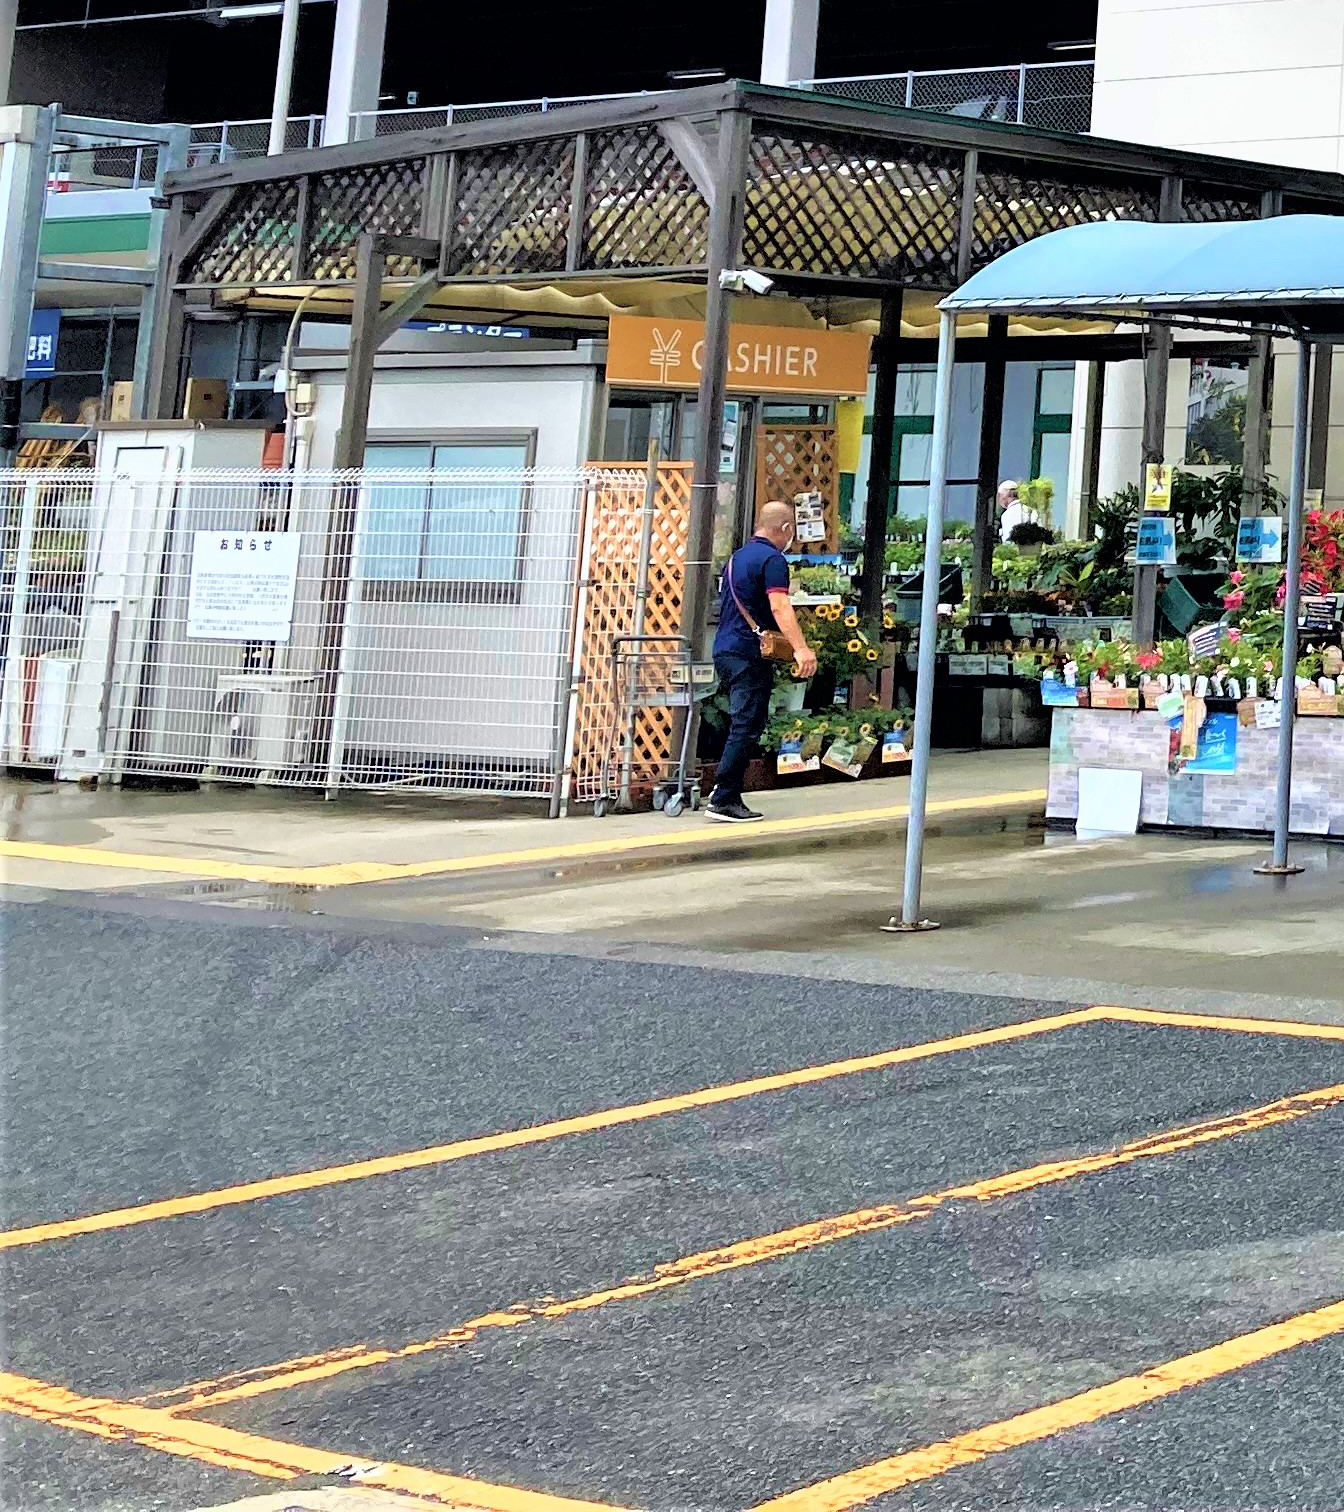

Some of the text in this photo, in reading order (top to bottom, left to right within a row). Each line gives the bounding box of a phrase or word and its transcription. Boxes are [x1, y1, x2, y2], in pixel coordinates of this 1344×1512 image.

[691, 339, 818, 377] CSHIER
[219, 538, 273, 552] お知らせ
